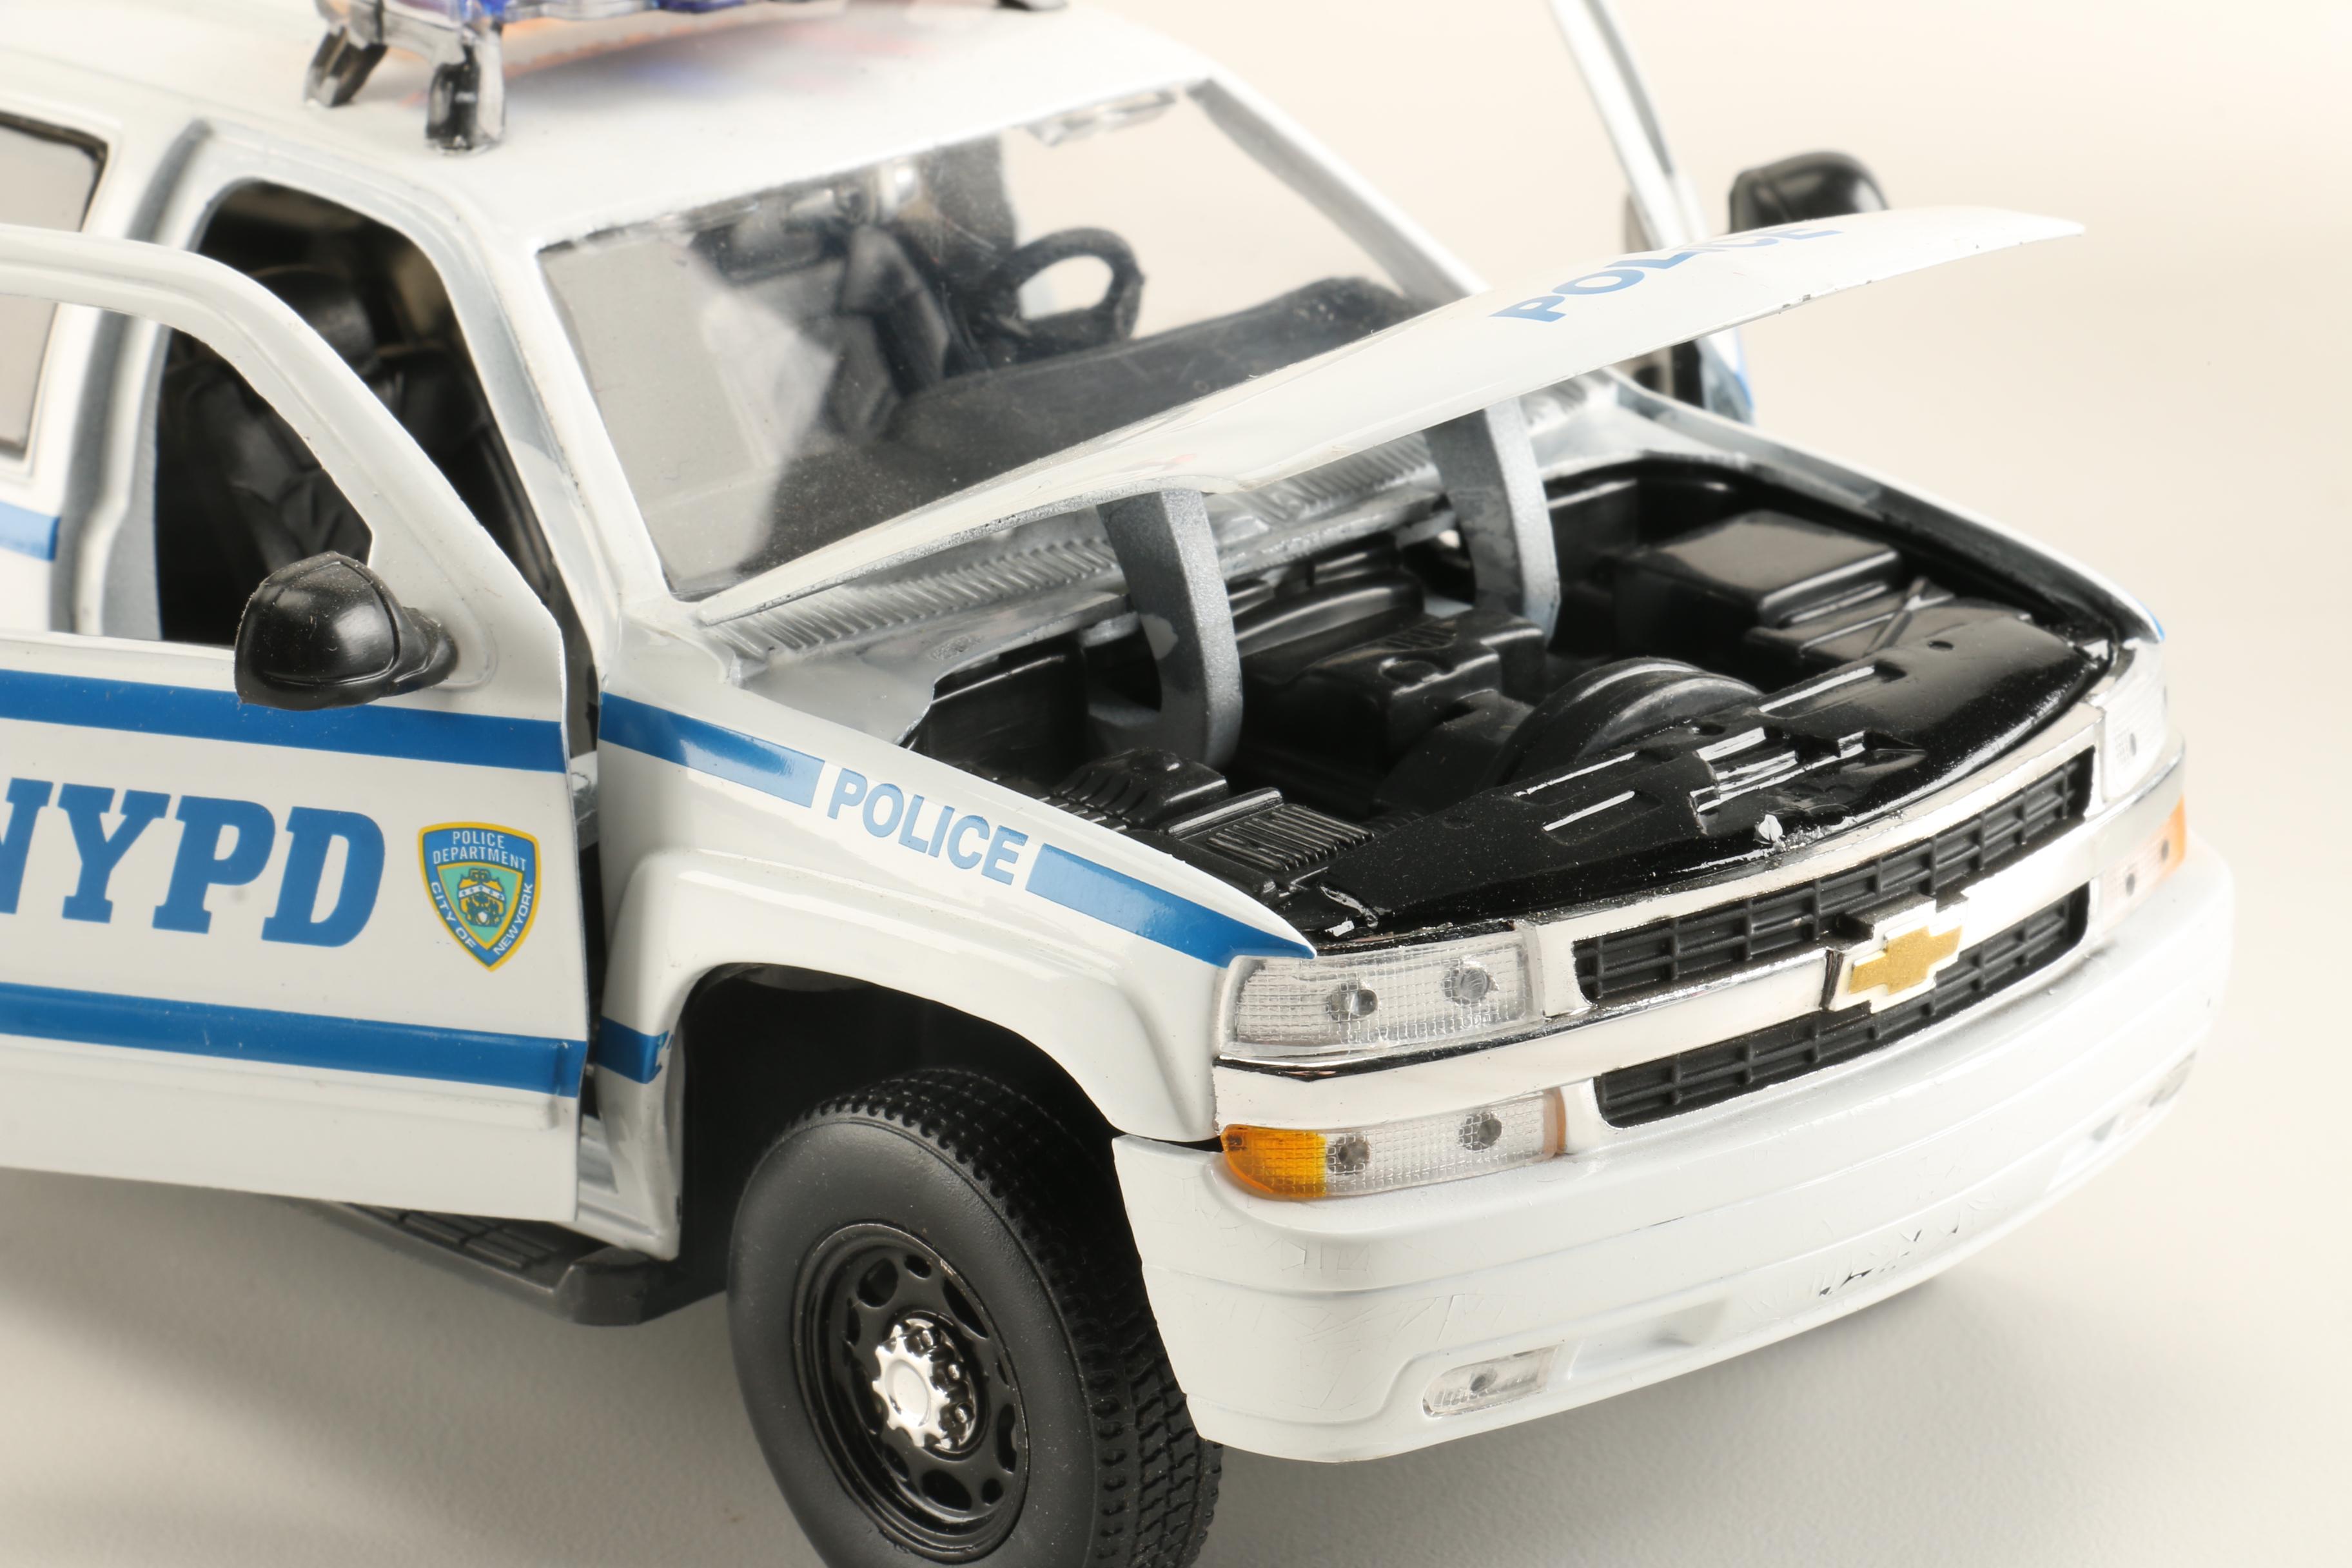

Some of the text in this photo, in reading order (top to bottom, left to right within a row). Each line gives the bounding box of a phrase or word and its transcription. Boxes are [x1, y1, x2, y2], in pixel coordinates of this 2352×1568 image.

[1487, 228, 1843, 322] POLICE
[433, 847, 527, 871] DEPARTMENT
[453, 830, 505, 849] POLICE
[827, 767, 1029, 886] POLICE
[431, 881, 476, 948] CITY OF
[493, 883, 534, 956] NEW YORK
